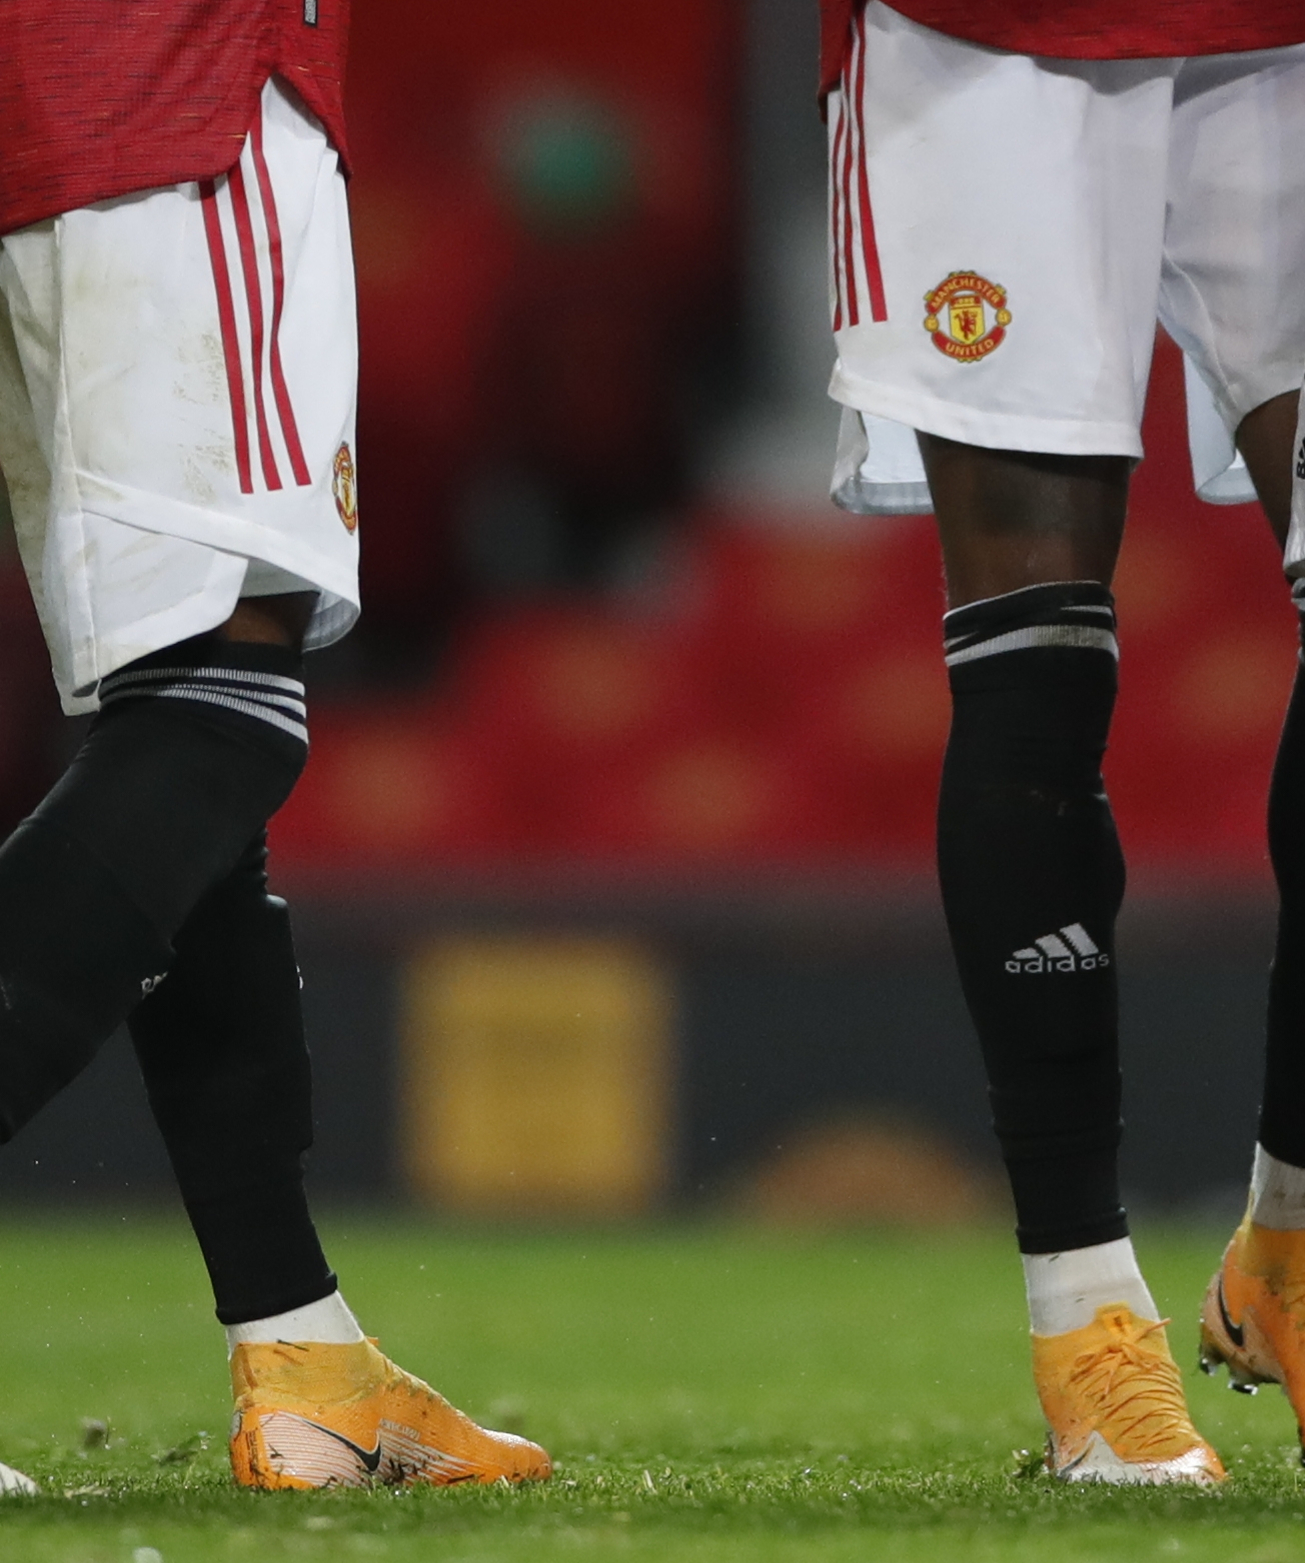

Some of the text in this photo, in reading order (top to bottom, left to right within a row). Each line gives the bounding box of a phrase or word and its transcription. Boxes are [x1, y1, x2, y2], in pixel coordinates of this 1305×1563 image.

[931, 277, 1000, 306] MANCHESTER
[945, 338, 994, 355] UNITED
[1004, 953, 1110, 974] adidas
